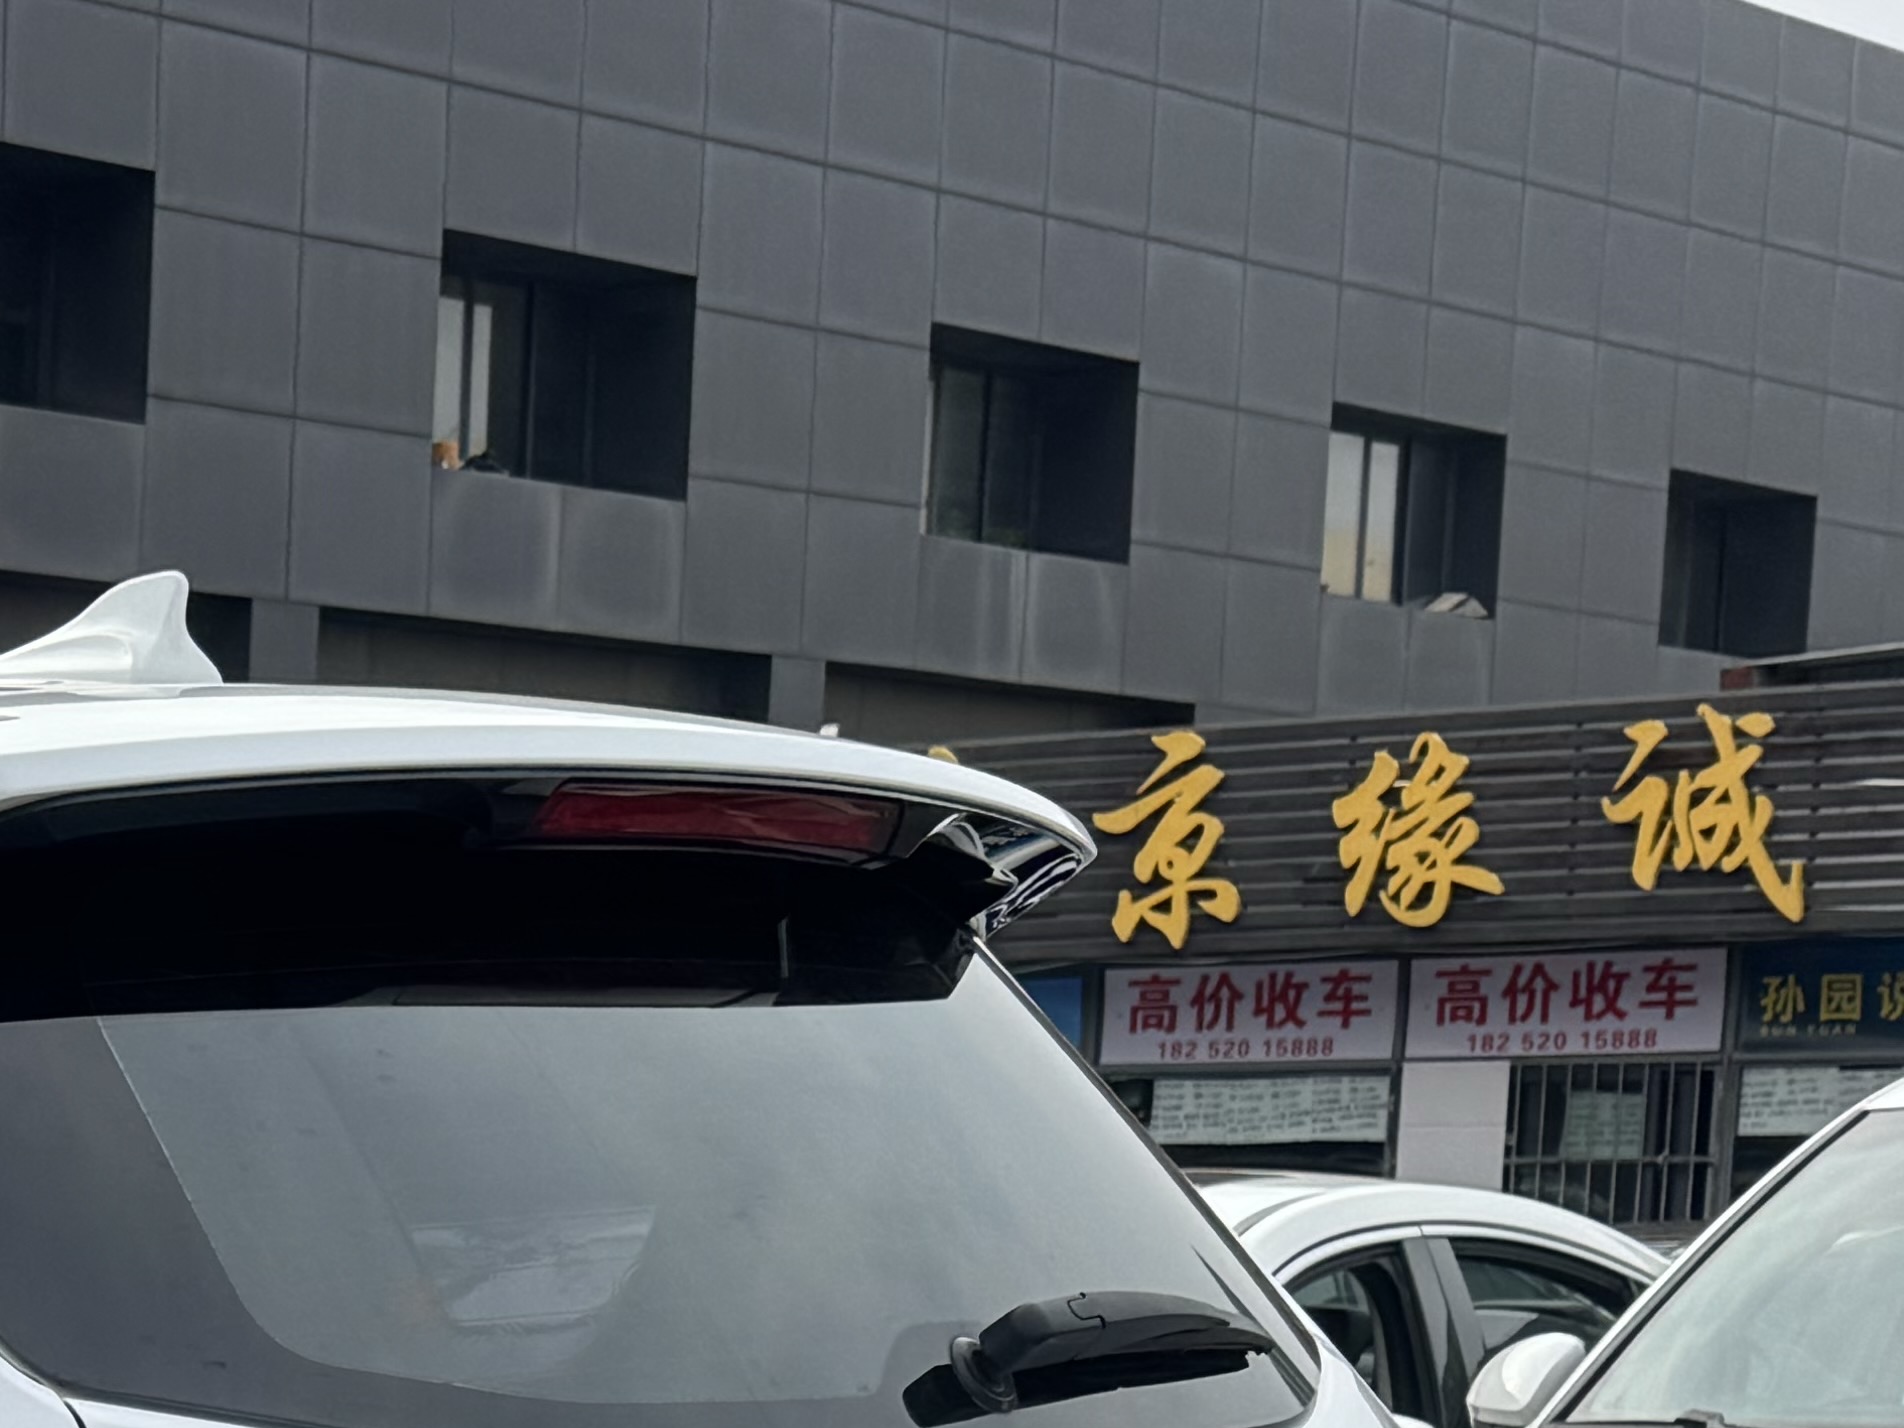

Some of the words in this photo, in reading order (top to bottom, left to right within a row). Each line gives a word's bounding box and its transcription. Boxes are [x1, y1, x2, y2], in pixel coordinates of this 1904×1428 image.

[1128, 968, 1373, 1035] 高价收车
[1435, 957, 1700, 1028] 高价收车
[1158, 1041, 1197, 1059] 182
[1208, 1039, 1250, 1058] 520
[1263, 1036, 1334, 1057] 15888
[1467, 1033, 1510, 1053] 182
[1520, 1030, 1567, 1051] 520
[1580, 1028, 1658, 1049] 15888
